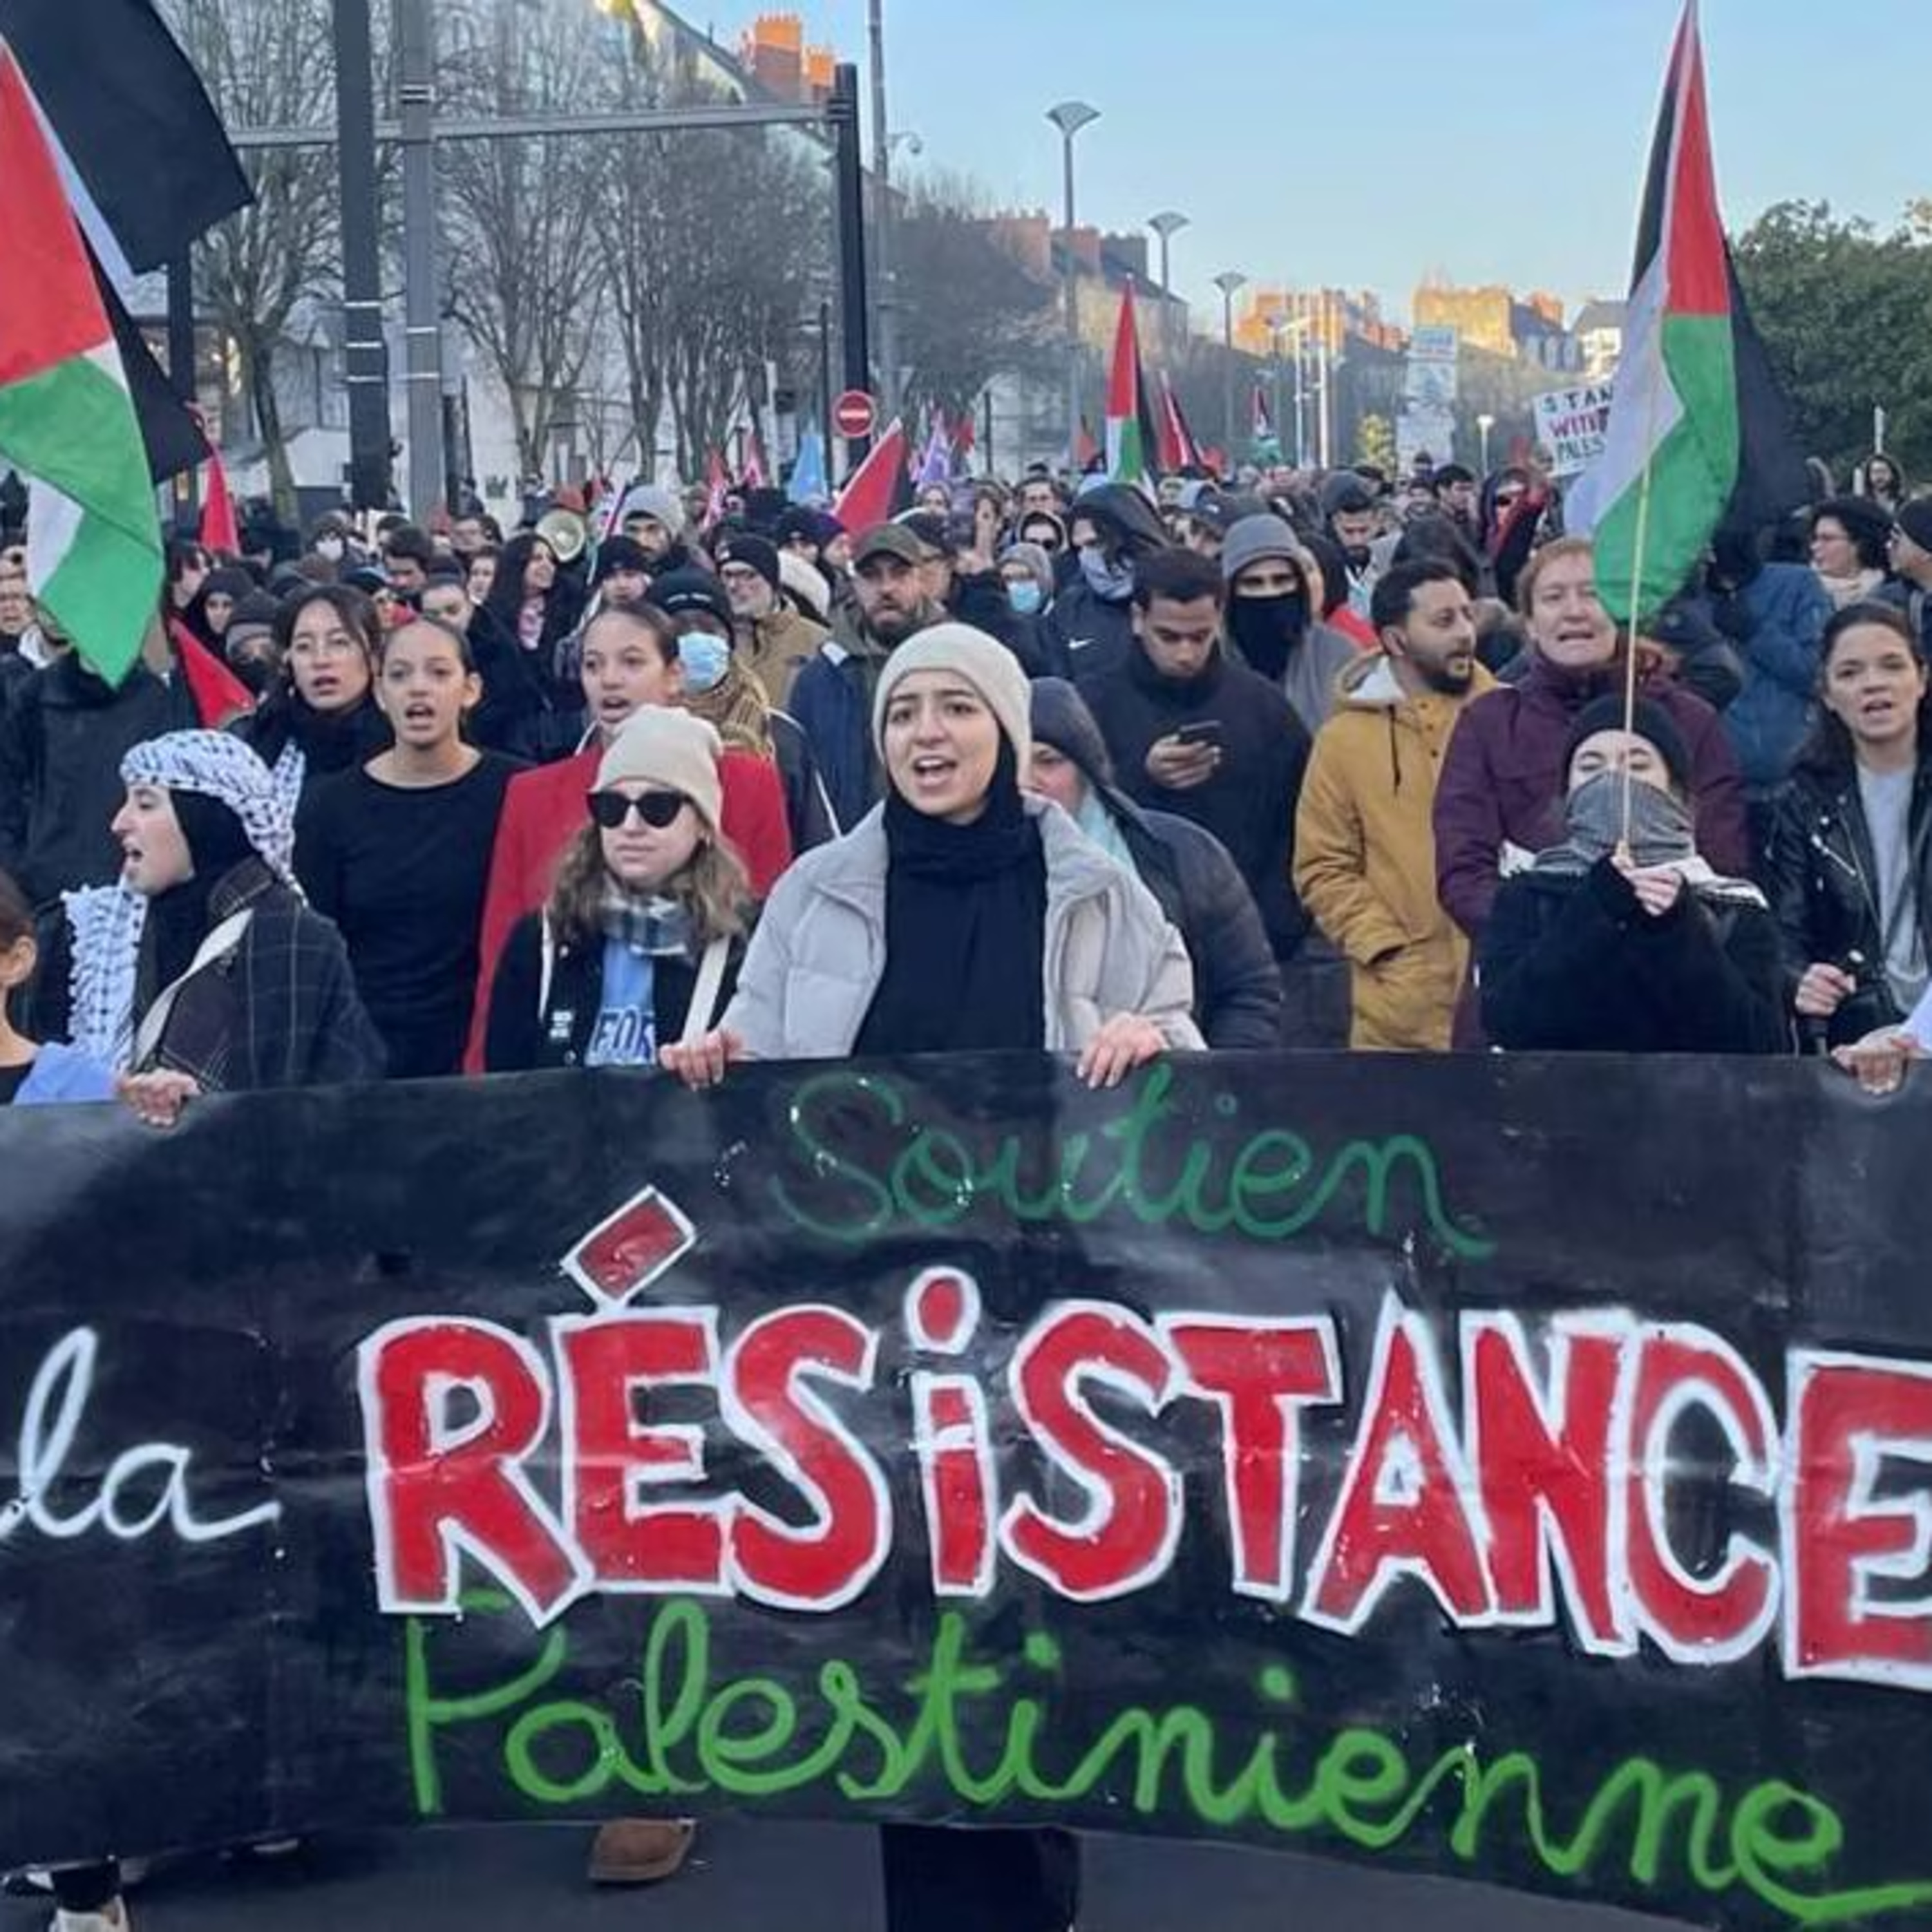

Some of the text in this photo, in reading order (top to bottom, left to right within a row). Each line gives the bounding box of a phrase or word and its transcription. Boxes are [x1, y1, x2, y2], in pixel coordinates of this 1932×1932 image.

[773, 1063, 1497, 1258] Soutien
[0, 1326, 281, 1540] la
[404, 1589, 1932, 1922] Palestinienne
